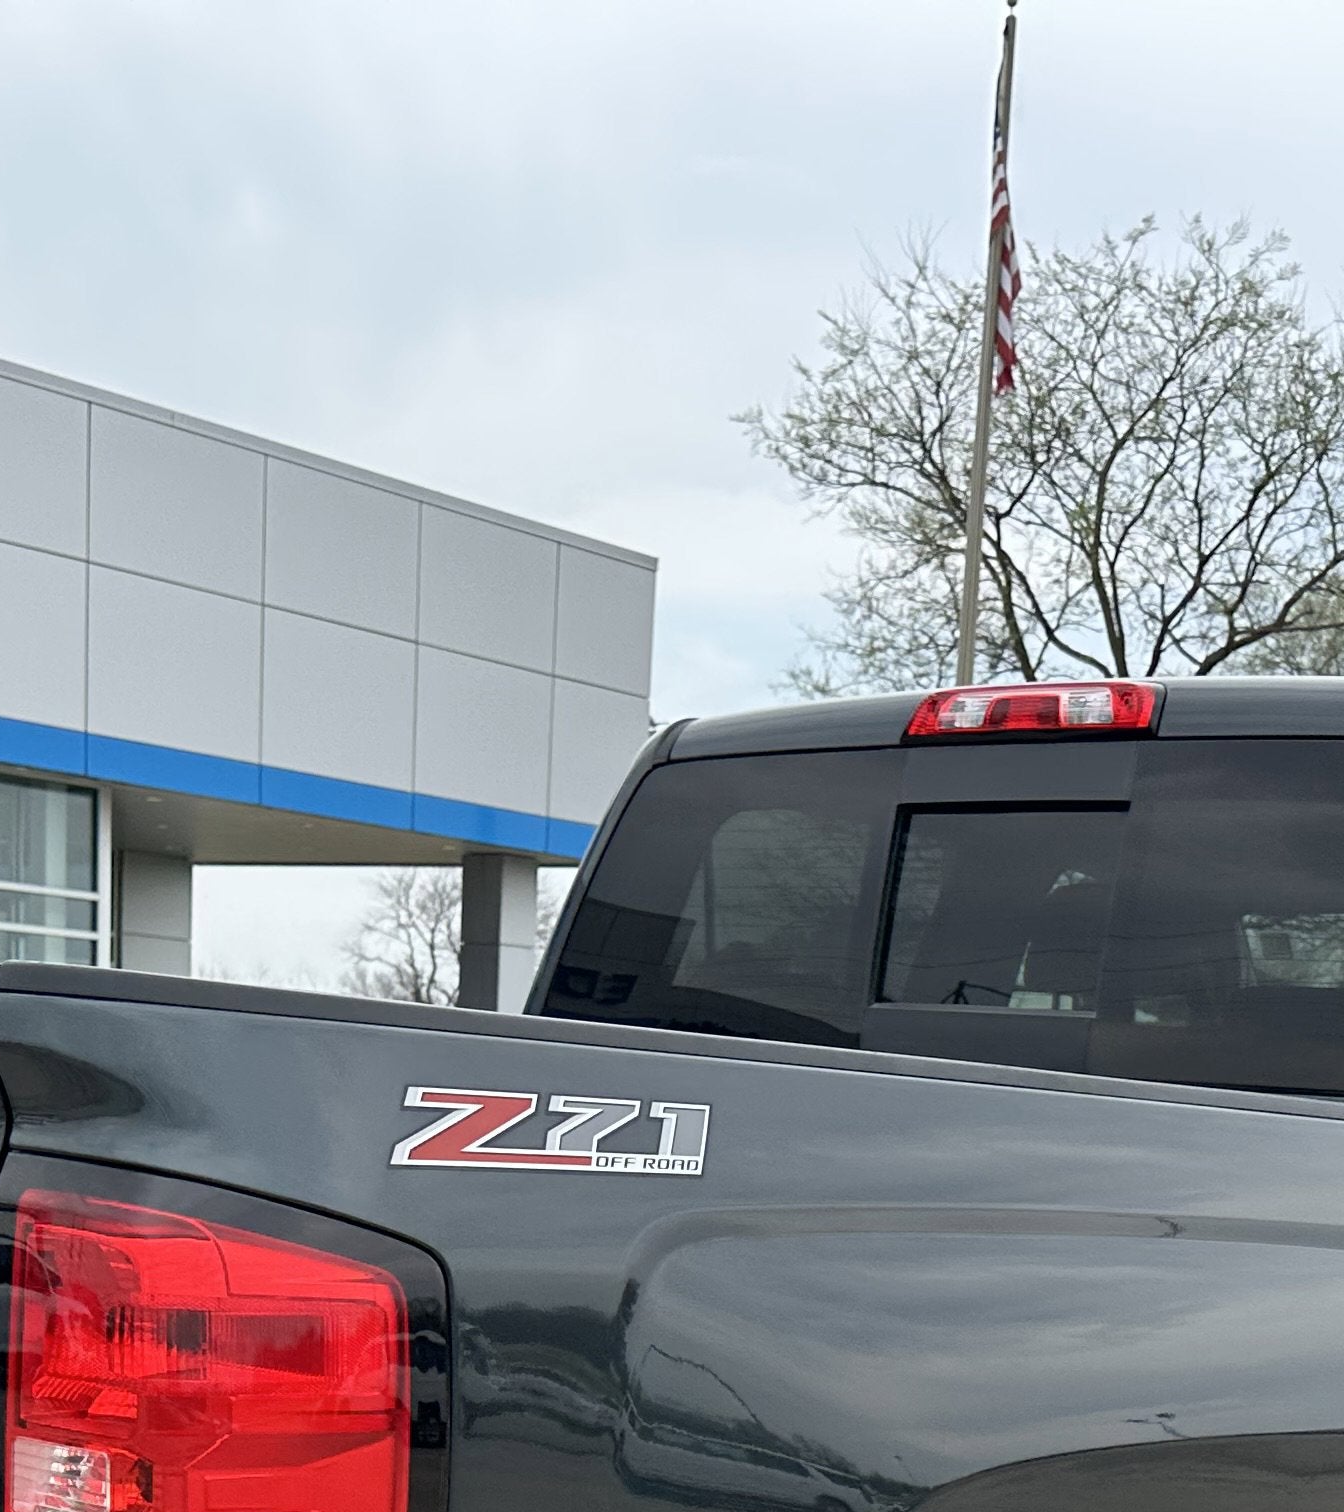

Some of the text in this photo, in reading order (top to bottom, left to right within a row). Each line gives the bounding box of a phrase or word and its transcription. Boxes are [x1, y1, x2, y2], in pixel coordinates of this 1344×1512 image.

[390, 1086, 710, 1173] Z71
[595, 1154, 700, 1173] OFF ROAD
